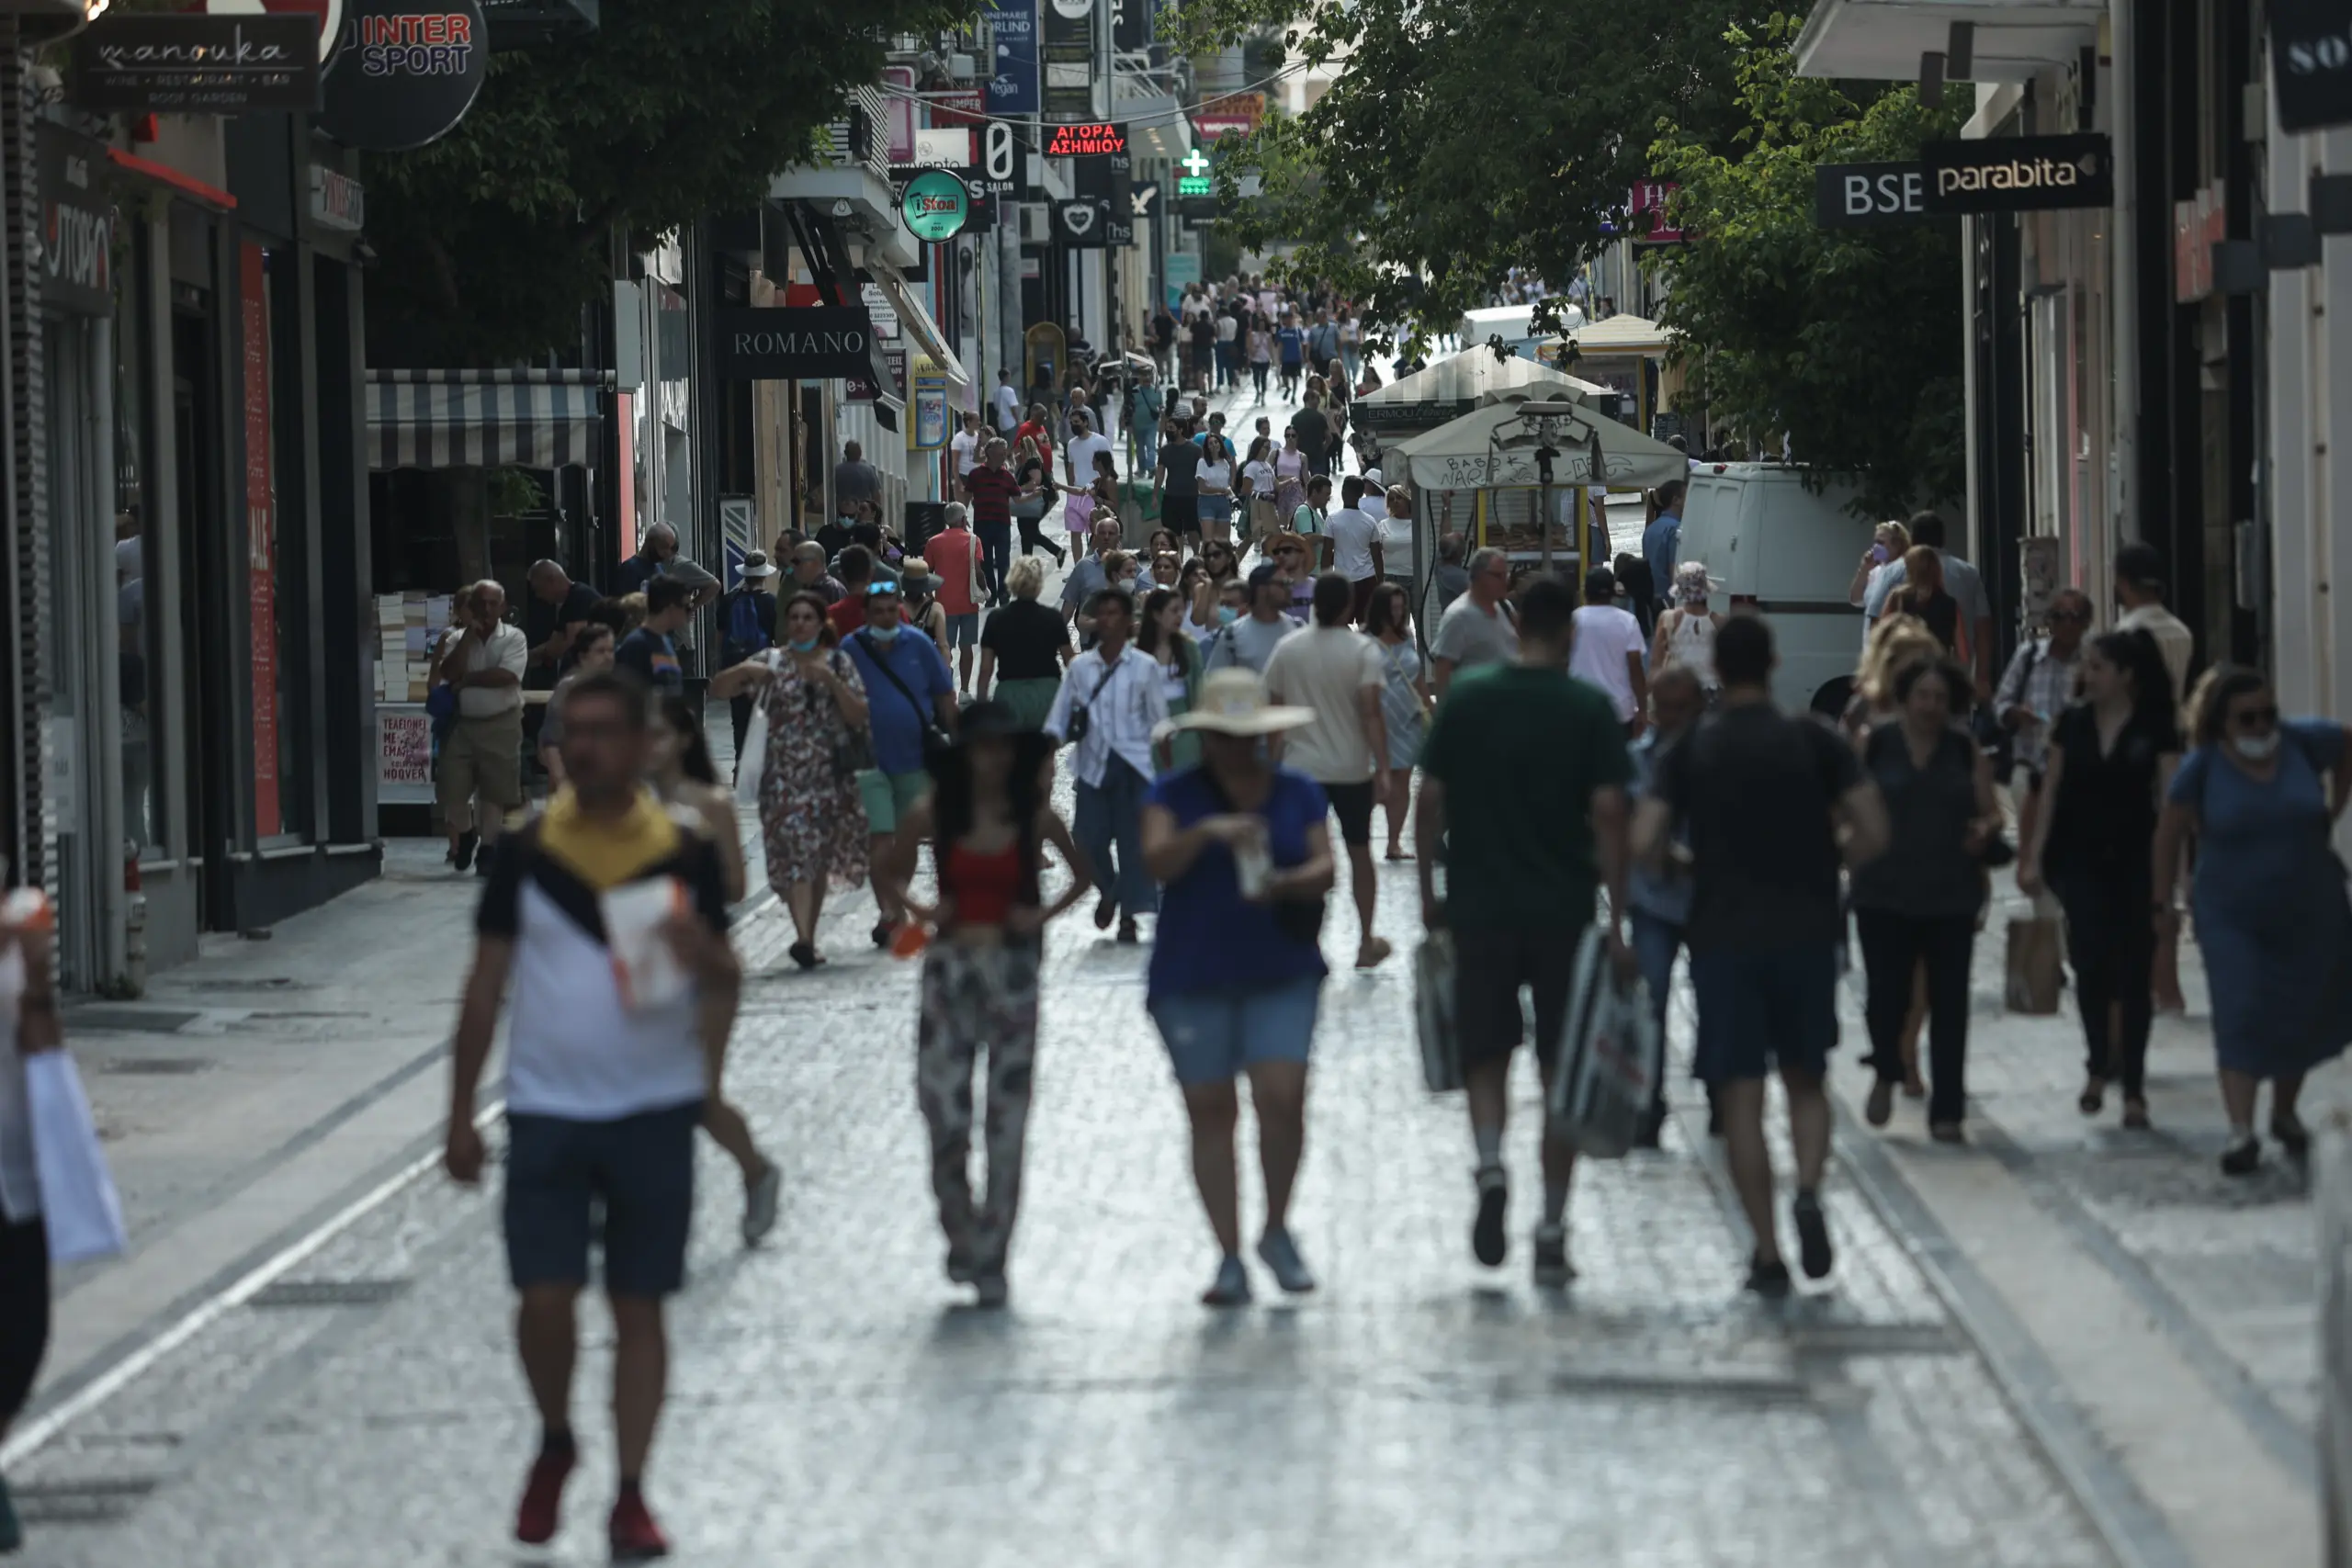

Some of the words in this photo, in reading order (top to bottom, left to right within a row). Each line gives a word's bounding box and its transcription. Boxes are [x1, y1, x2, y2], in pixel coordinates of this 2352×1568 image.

[982, 11, 1029, 20] NNEMARIE
[363, 14, 471, 45] INTER
[991, 21, 1031, 33] RLIND
[100, 23, 291, 70] manouka
[362, 45, 472, 76] SPORT
[1057, 125, 1115, 140] ΑΓΟΡΑ
[1049, 139, 1125, 154] ΑΣΗΜΙΟΥ
[1938, 157, 2076, 197] parabita
[987, 181, 1014, 193] SALON
[733, 331, 864, 355] ROMANO
[1368, 408, 1414, 420] ERMOU
[248, 506, 268, 570] ALE
[383, 768, 425, 781] HOOVER
